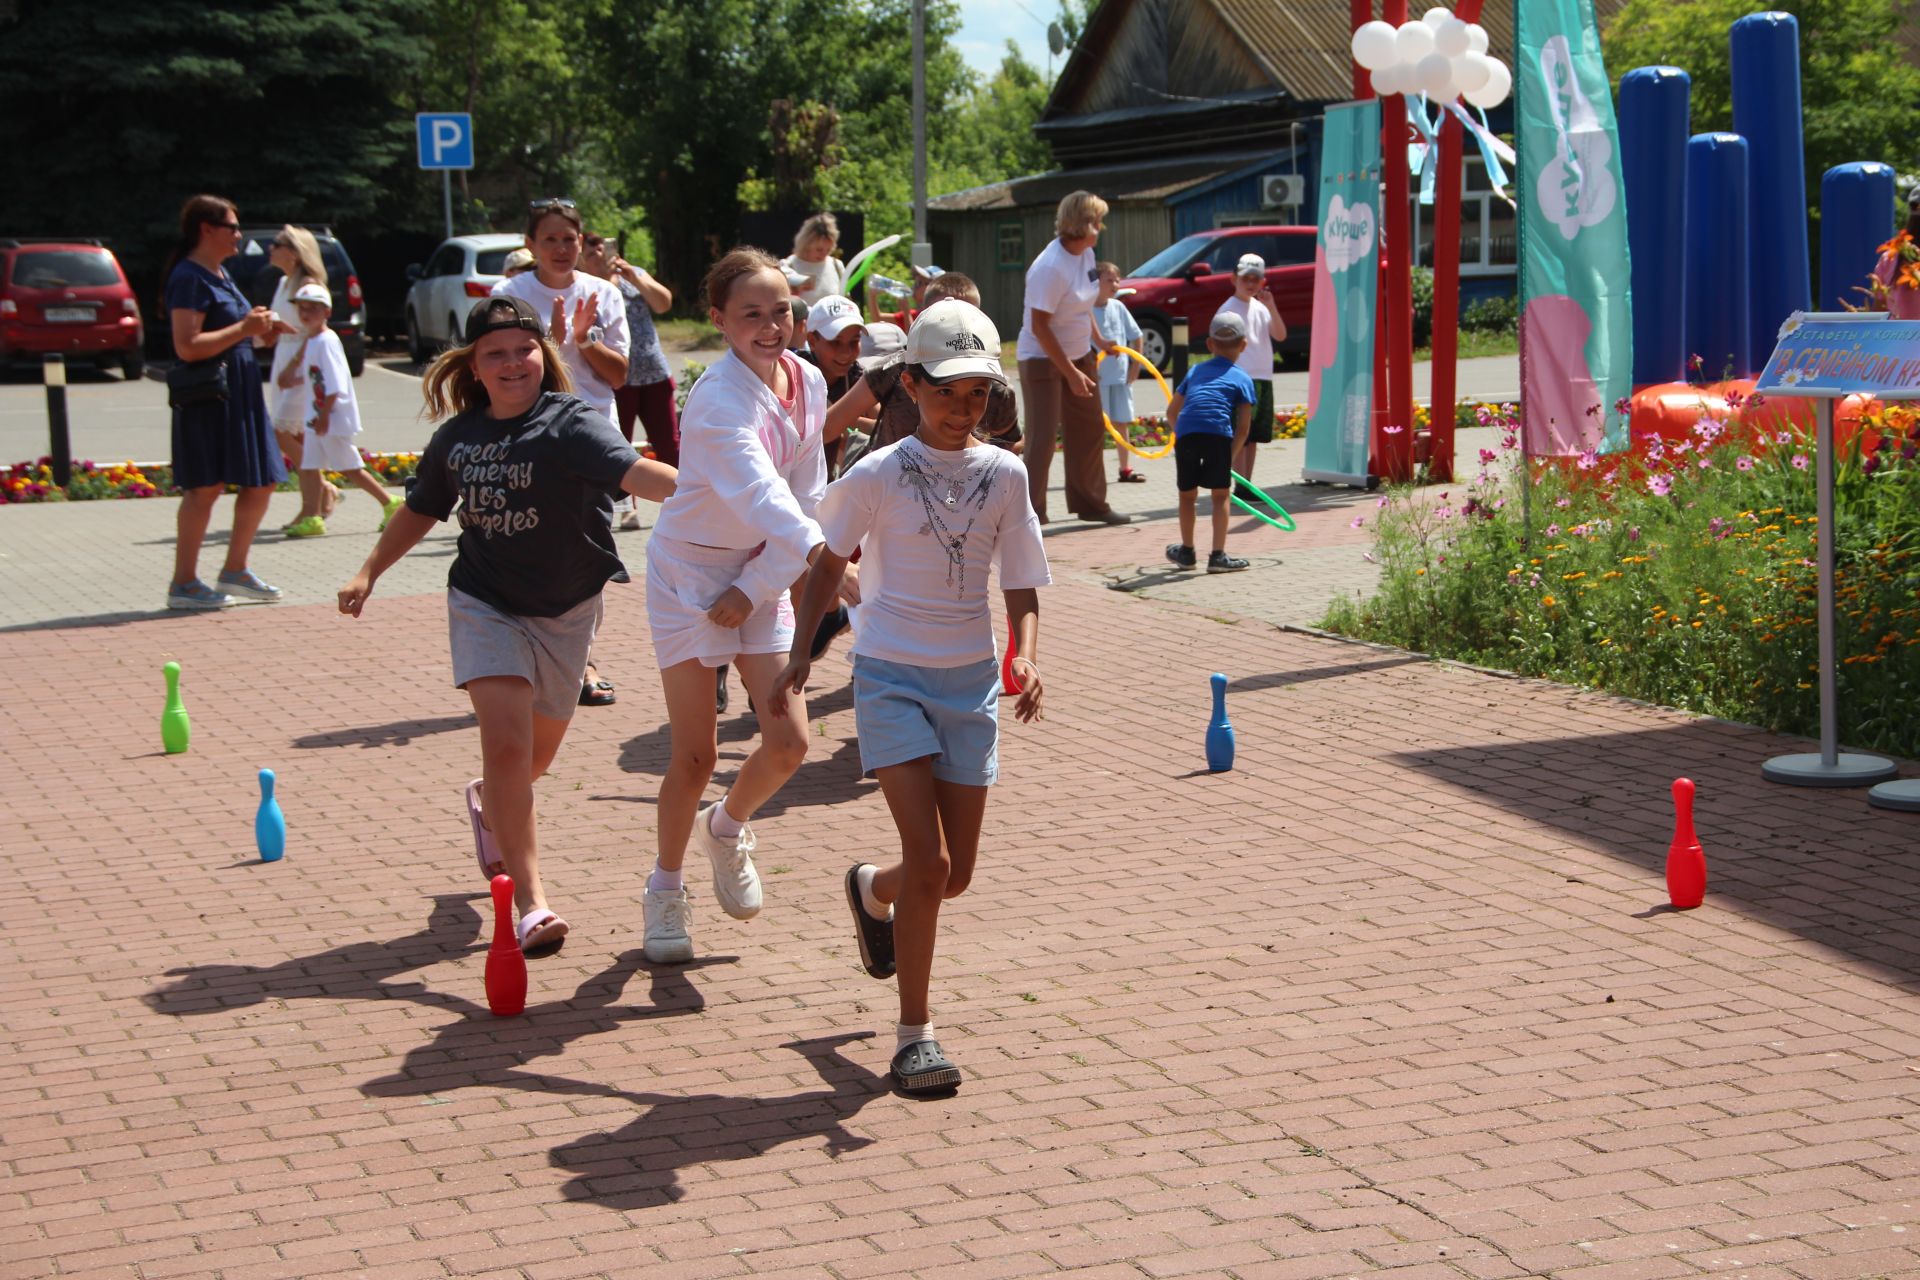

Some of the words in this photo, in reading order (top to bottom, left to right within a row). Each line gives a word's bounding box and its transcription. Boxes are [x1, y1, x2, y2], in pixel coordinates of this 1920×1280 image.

[432, 119, 462, 162] P
[946, 338, 973, 348] NORTH
[956, 330, 972, 339] THE
[1794, 343, 1899, 385] СЕМЕЙНОМ
[1894, 359, 1920, 387] КР
[448, 434, 512, 471] Great
[463, 461, 533, 489] energy
[469, 485, 506, 513] Los
